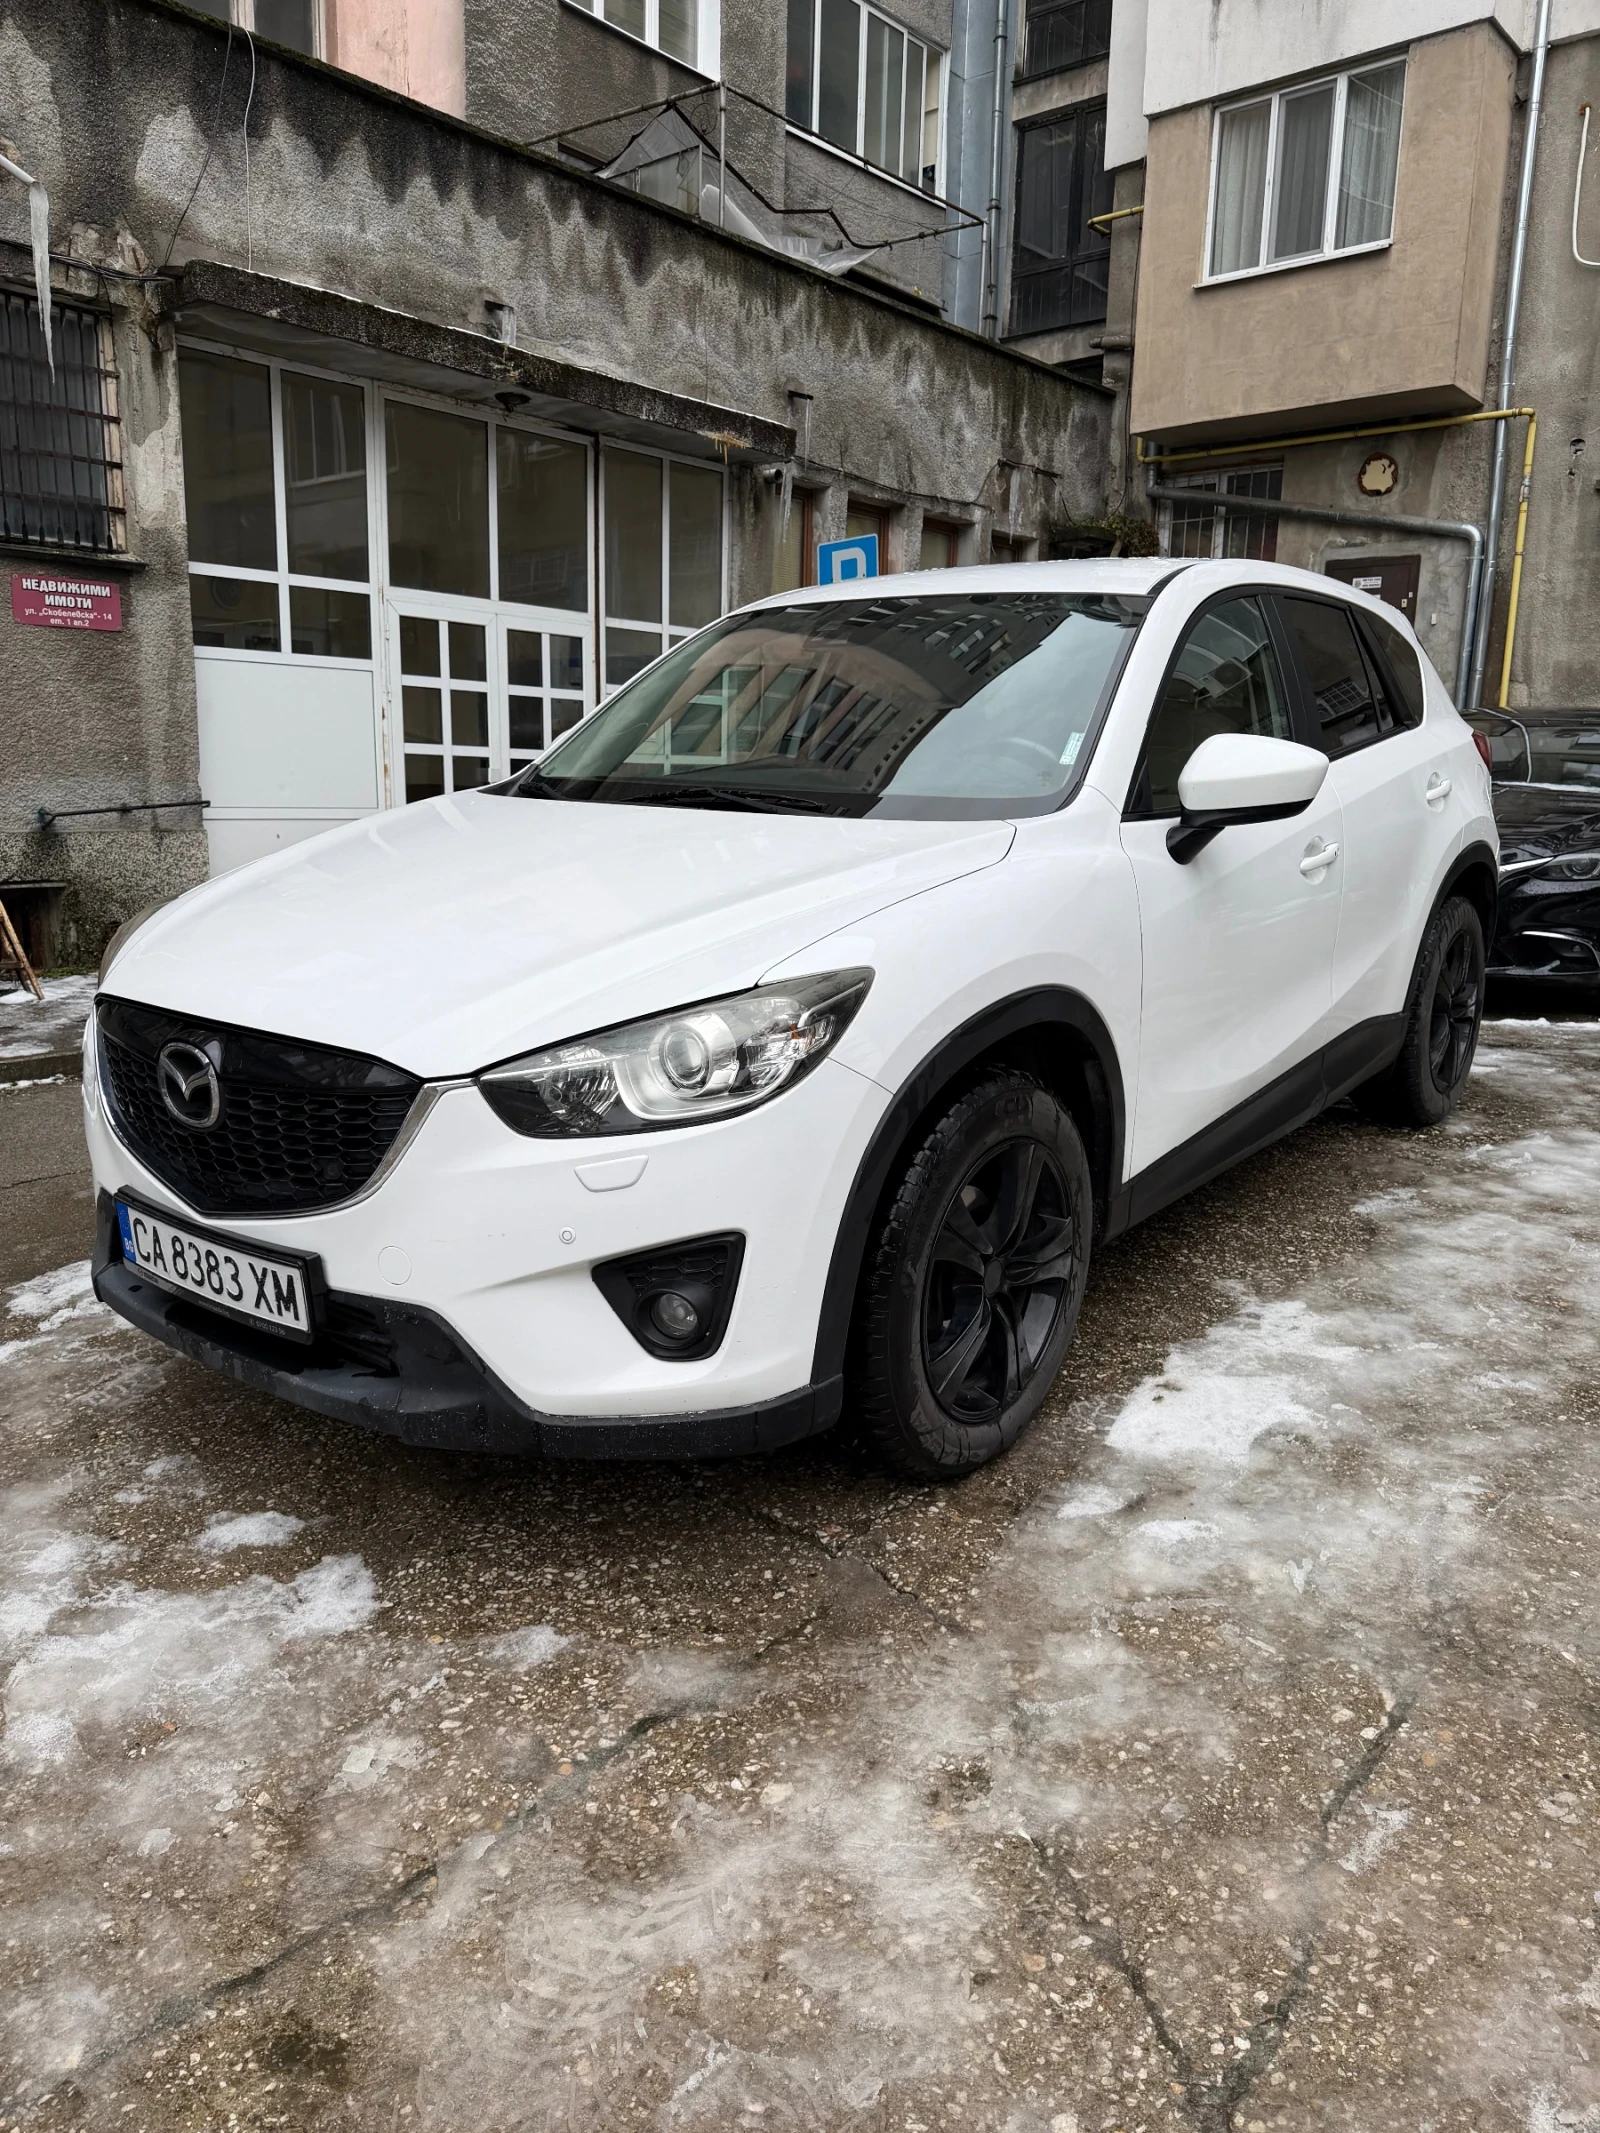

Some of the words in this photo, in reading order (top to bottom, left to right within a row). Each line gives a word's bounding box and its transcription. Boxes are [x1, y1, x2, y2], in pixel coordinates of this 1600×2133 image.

[22, 578, 111, 597] НЕДВИЖИМИ
[45, 595, 92, 609] ИМОТИ
[25, 608, 37, 616] ул.
[103, 613, 112, 621] 14
[124, 1237, 134, 1254] BG
[171, 1235, 244, 1301] 8383
